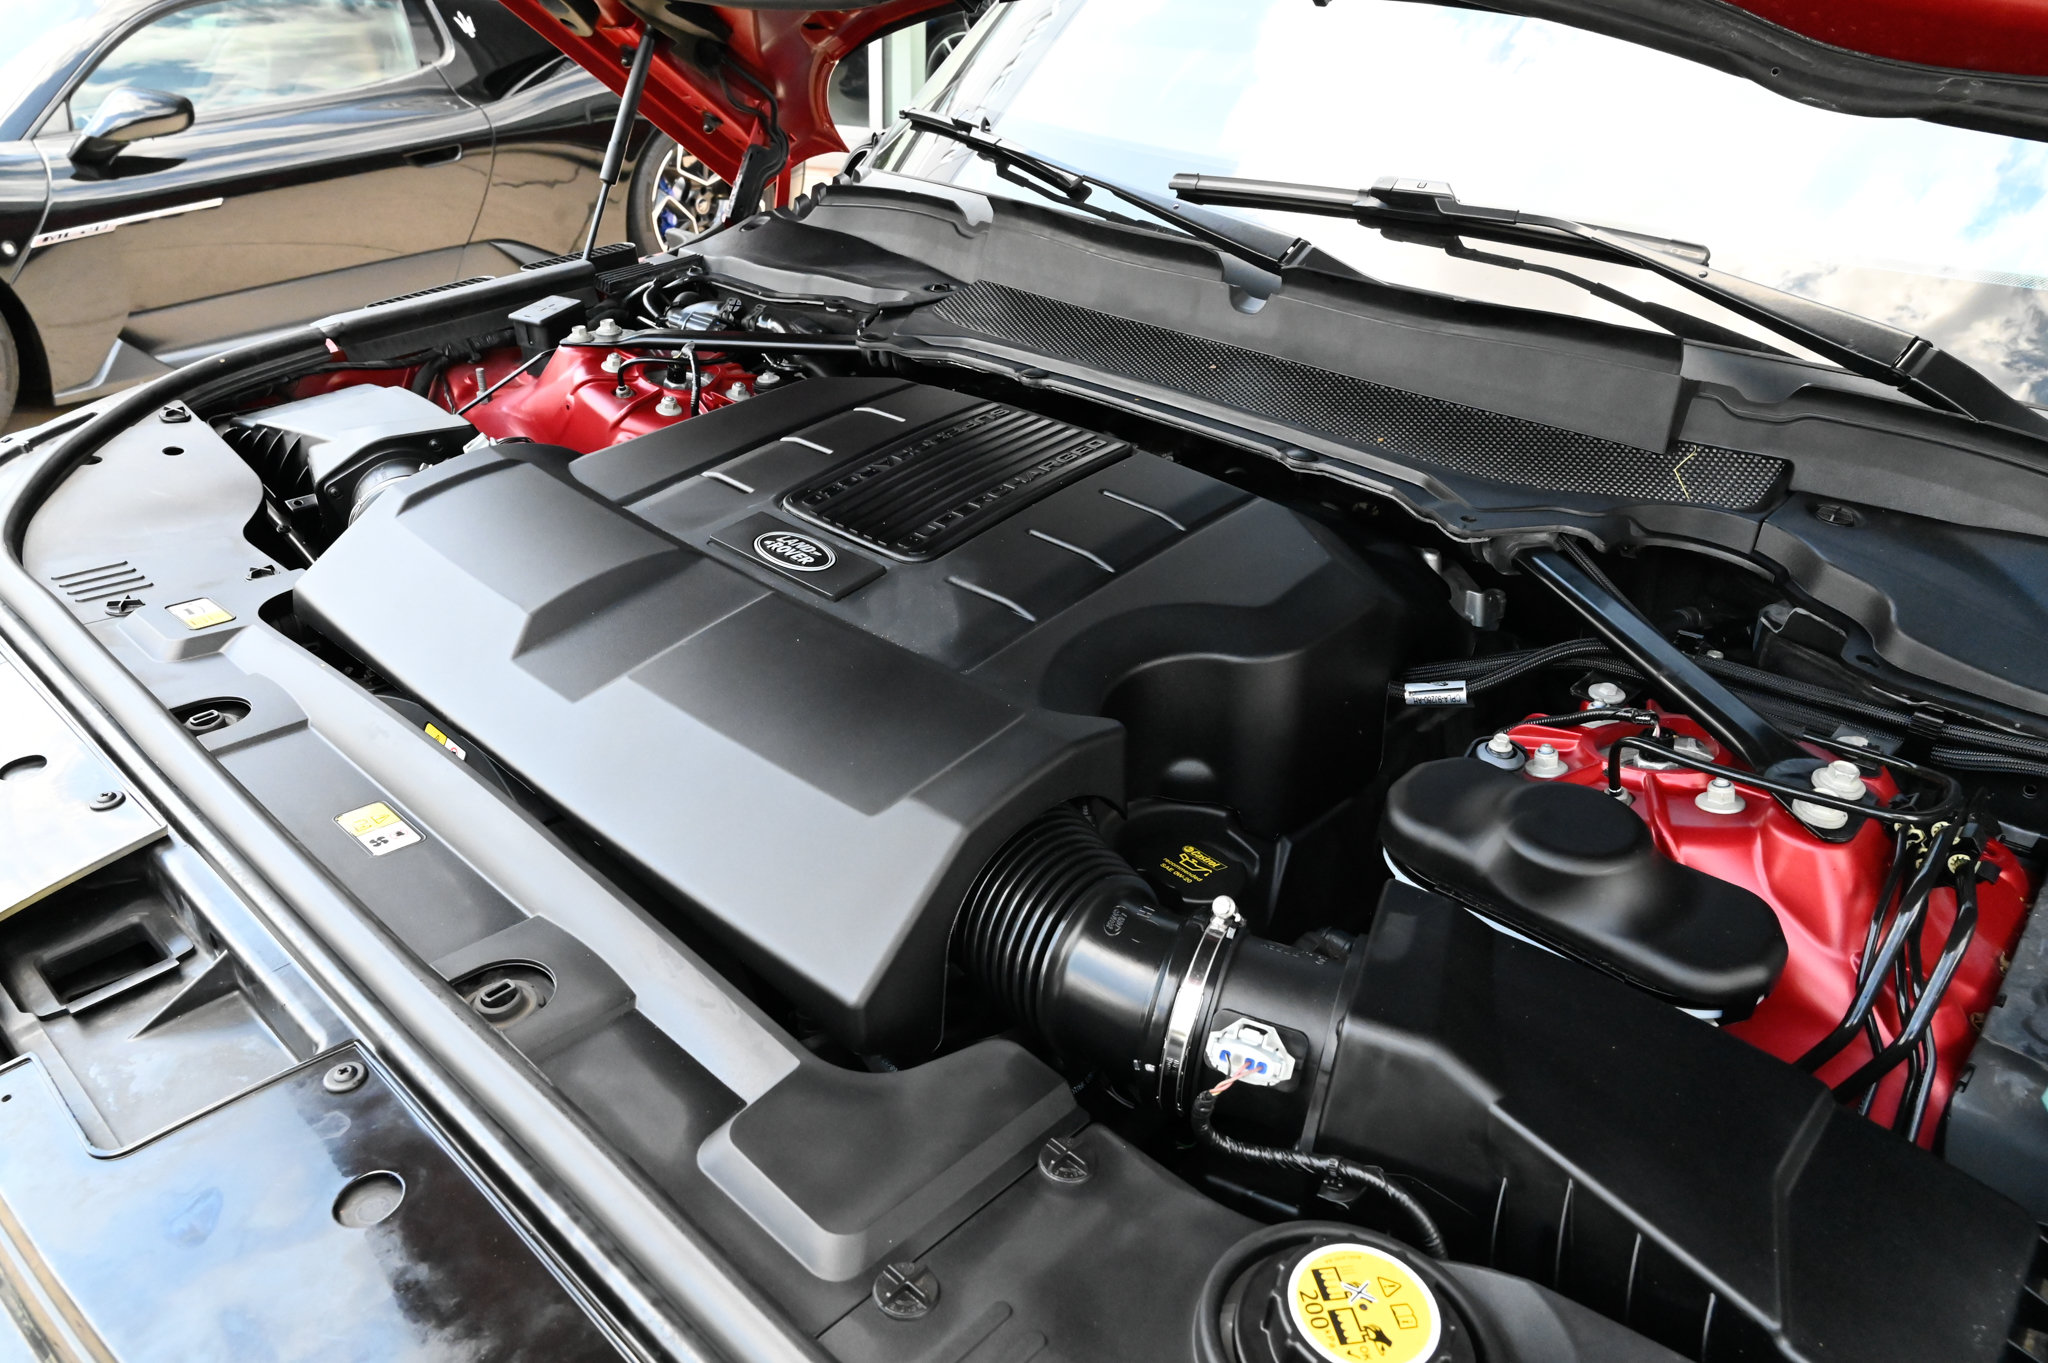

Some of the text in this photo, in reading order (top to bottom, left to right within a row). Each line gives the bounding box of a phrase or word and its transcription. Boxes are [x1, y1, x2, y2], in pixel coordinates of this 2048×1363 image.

[766, 542, 815, 565] ROVER
[776, 536, 817, 553] LAND
[1160, 862, 1175, 872] SAE
[1190, 850, 1221, 868] Castrol
[1163, 857, 1203, 882] recommended
[1299, 1289, 1330, 1329] 200
